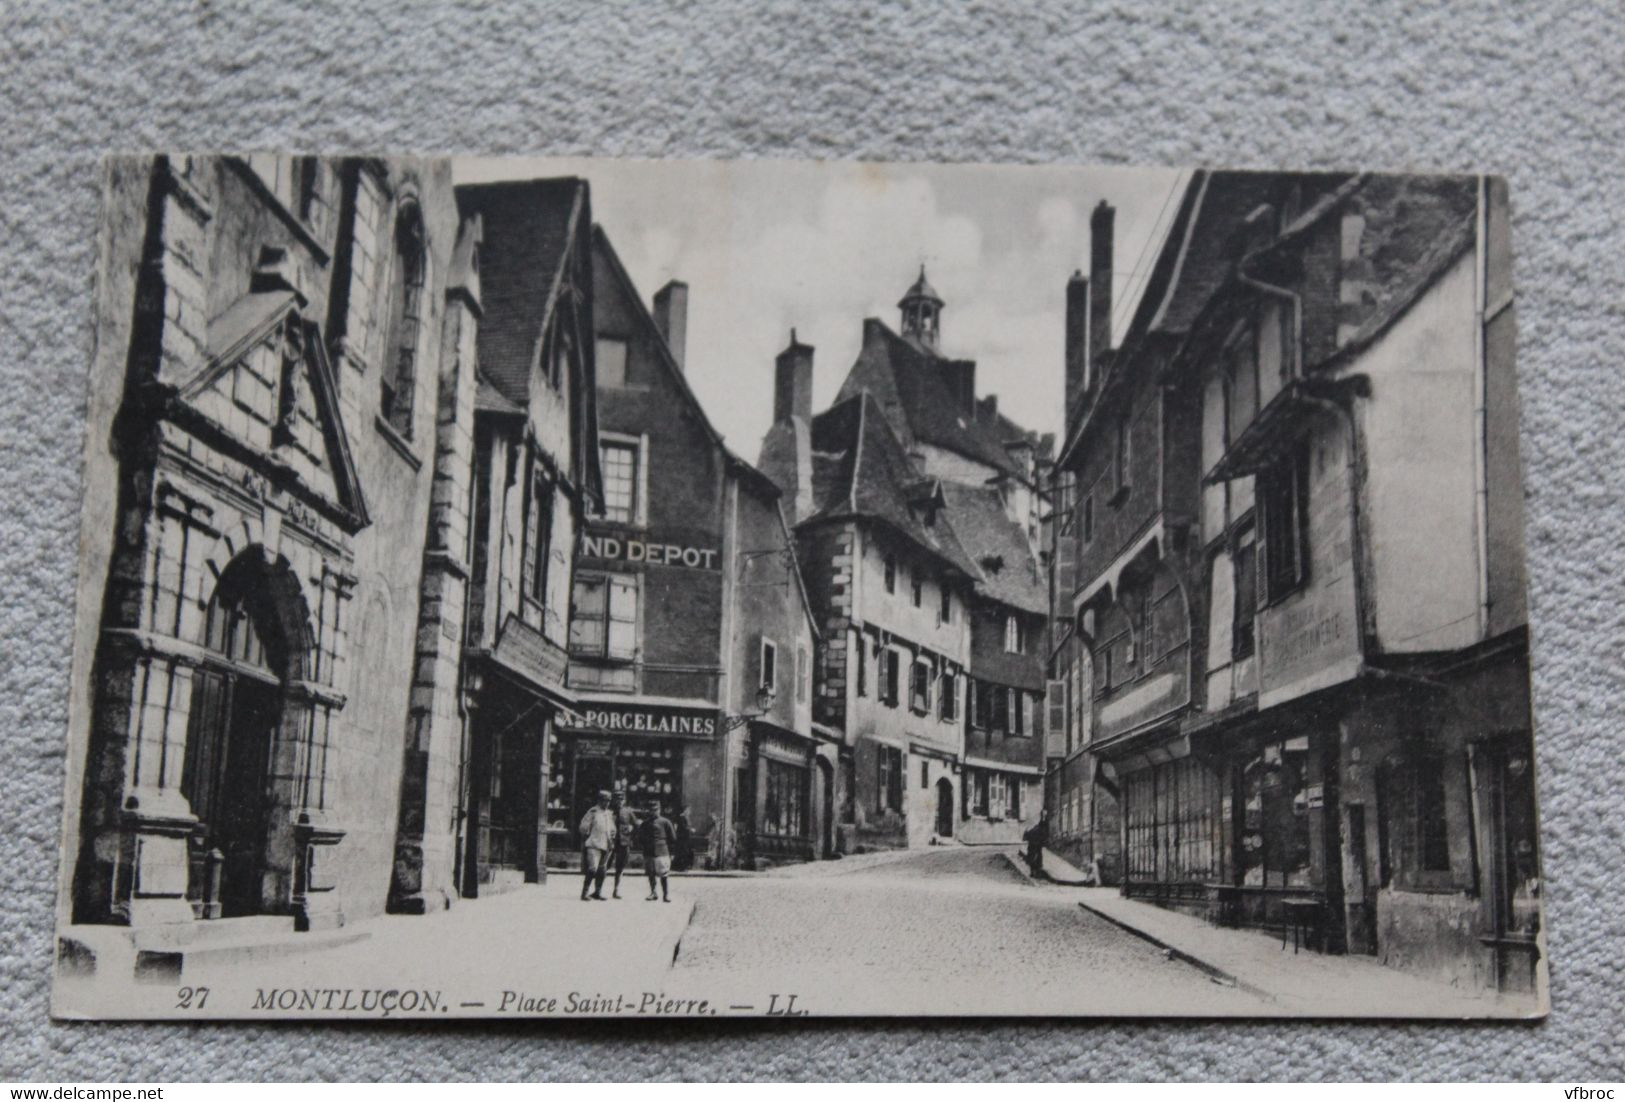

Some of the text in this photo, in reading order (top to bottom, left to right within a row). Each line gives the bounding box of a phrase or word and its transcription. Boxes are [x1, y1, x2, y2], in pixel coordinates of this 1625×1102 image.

[583, 536, 717, 568] ND DEPOT
[586, 710, 715, 734] PORCELAINES
[175, 986, 210, 1010] 27
[251, 988, 448, 1017] MONTLUÇON.
[497, 990, 557, 1013] Place
[563, 991, 716, 1016] Saint-Pierre.
[766, 994, 809, 1016] LL.
